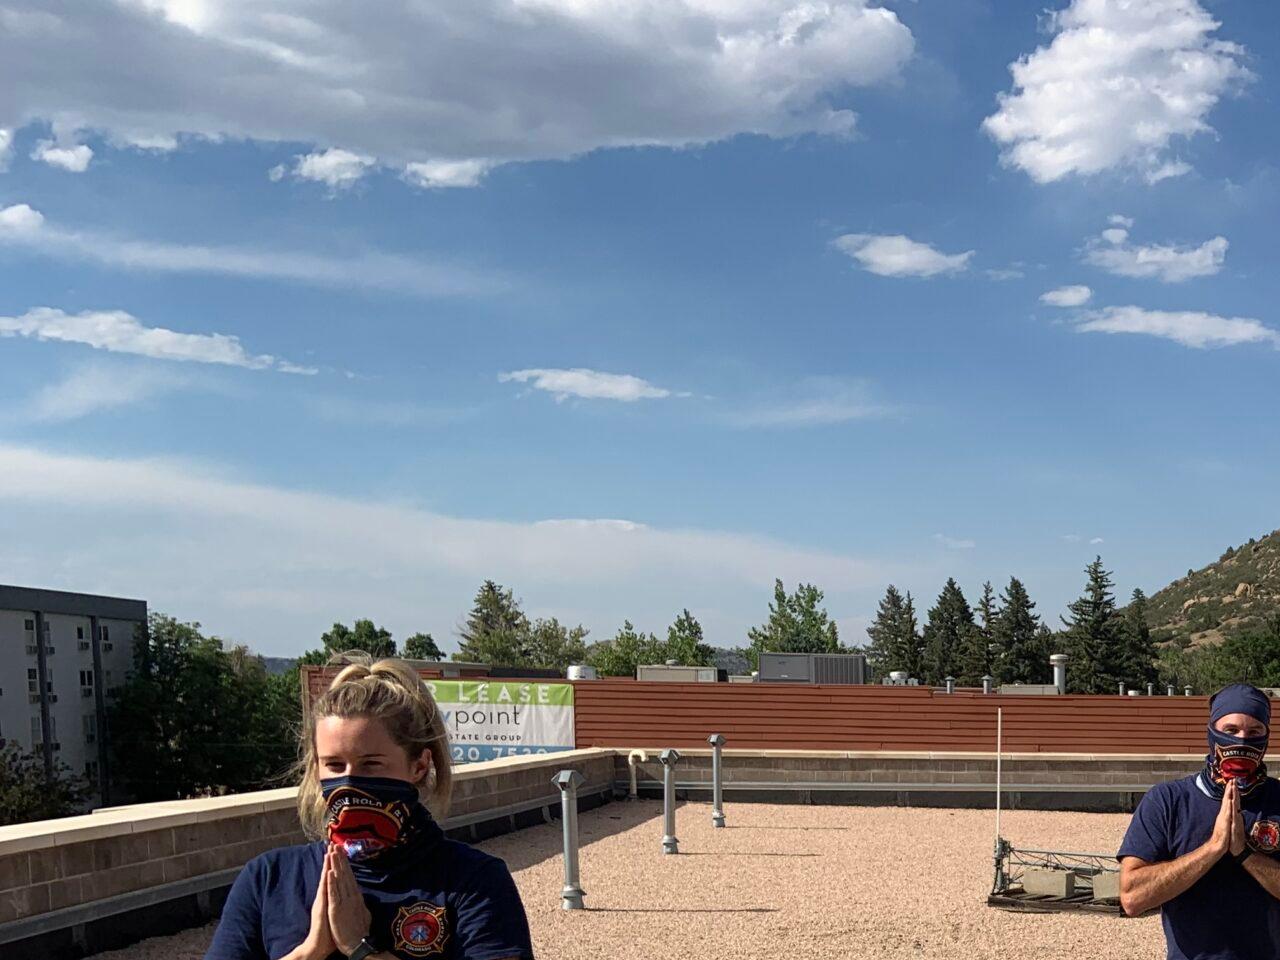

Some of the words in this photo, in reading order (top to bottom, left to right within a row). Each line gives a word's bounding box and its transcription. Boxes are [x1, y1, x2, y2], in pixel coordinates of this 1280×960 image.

[458, 682, 550, 703] LEASE
[448, 733, 479, 741] STATE
[485, 734, 522, 742] GROUP
